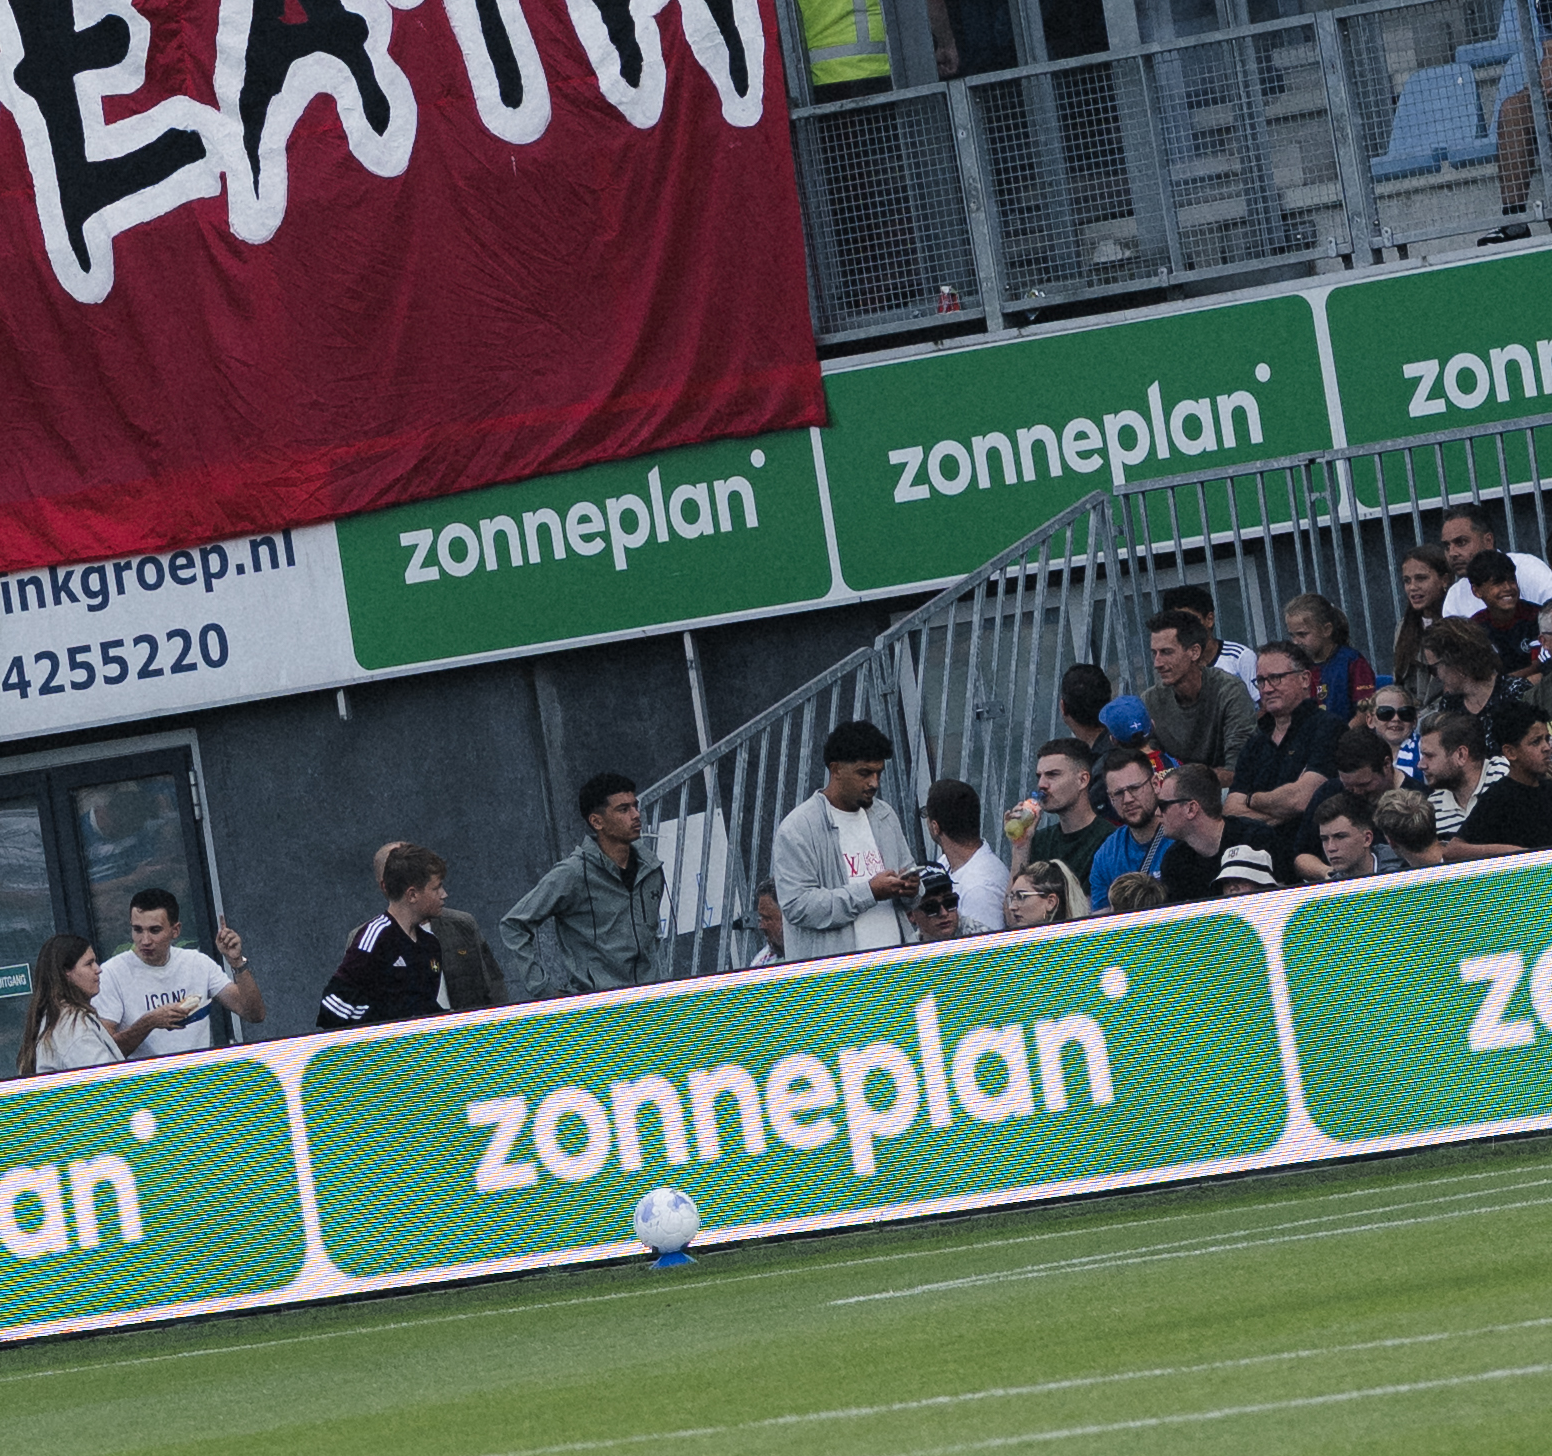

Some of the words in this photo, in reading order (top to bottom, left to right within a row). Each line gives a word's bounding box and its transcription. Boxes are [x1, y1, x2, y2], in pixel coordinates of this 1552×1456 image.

[888, 380, 1265, 504] zonneplan
[399, 464, 760, 585] zonneplan
[466, 996, 1114, 1191] zonneplan
